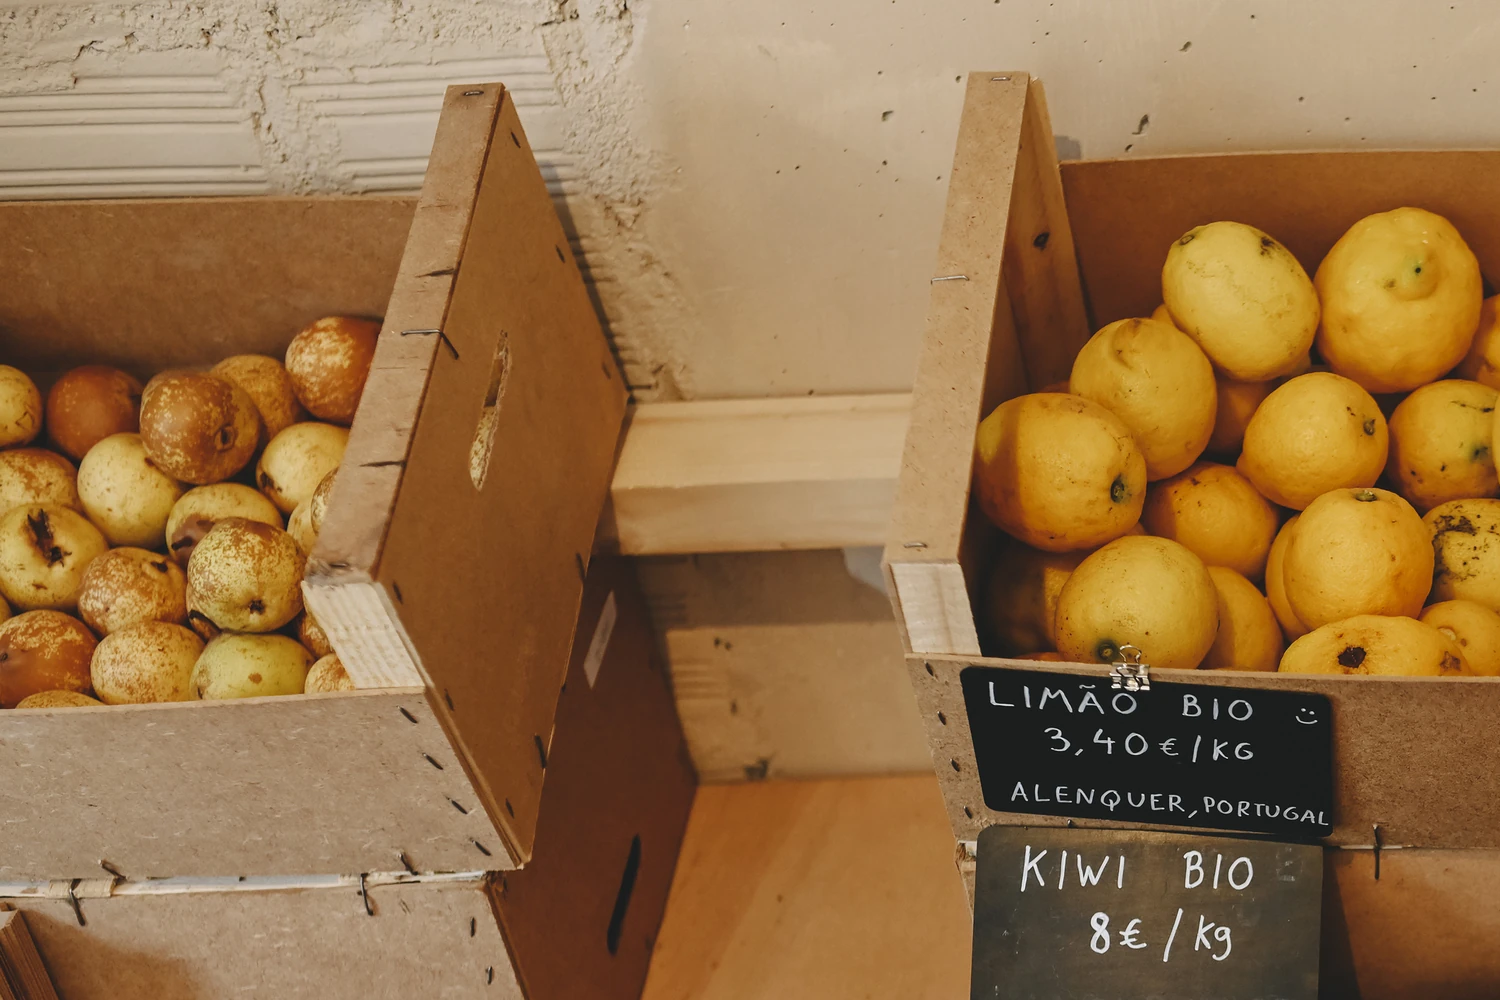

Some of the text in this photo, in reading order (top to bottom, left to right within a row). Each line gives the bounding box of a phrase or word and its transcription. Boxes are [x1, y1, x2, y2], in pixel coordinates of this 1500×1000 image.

[987, 681, 1255, 722] LIMÃO BIO
[1203, 795, 1330, 827] PORTUGAL
[1020, 844, 1255, 893] KIWI BIO
